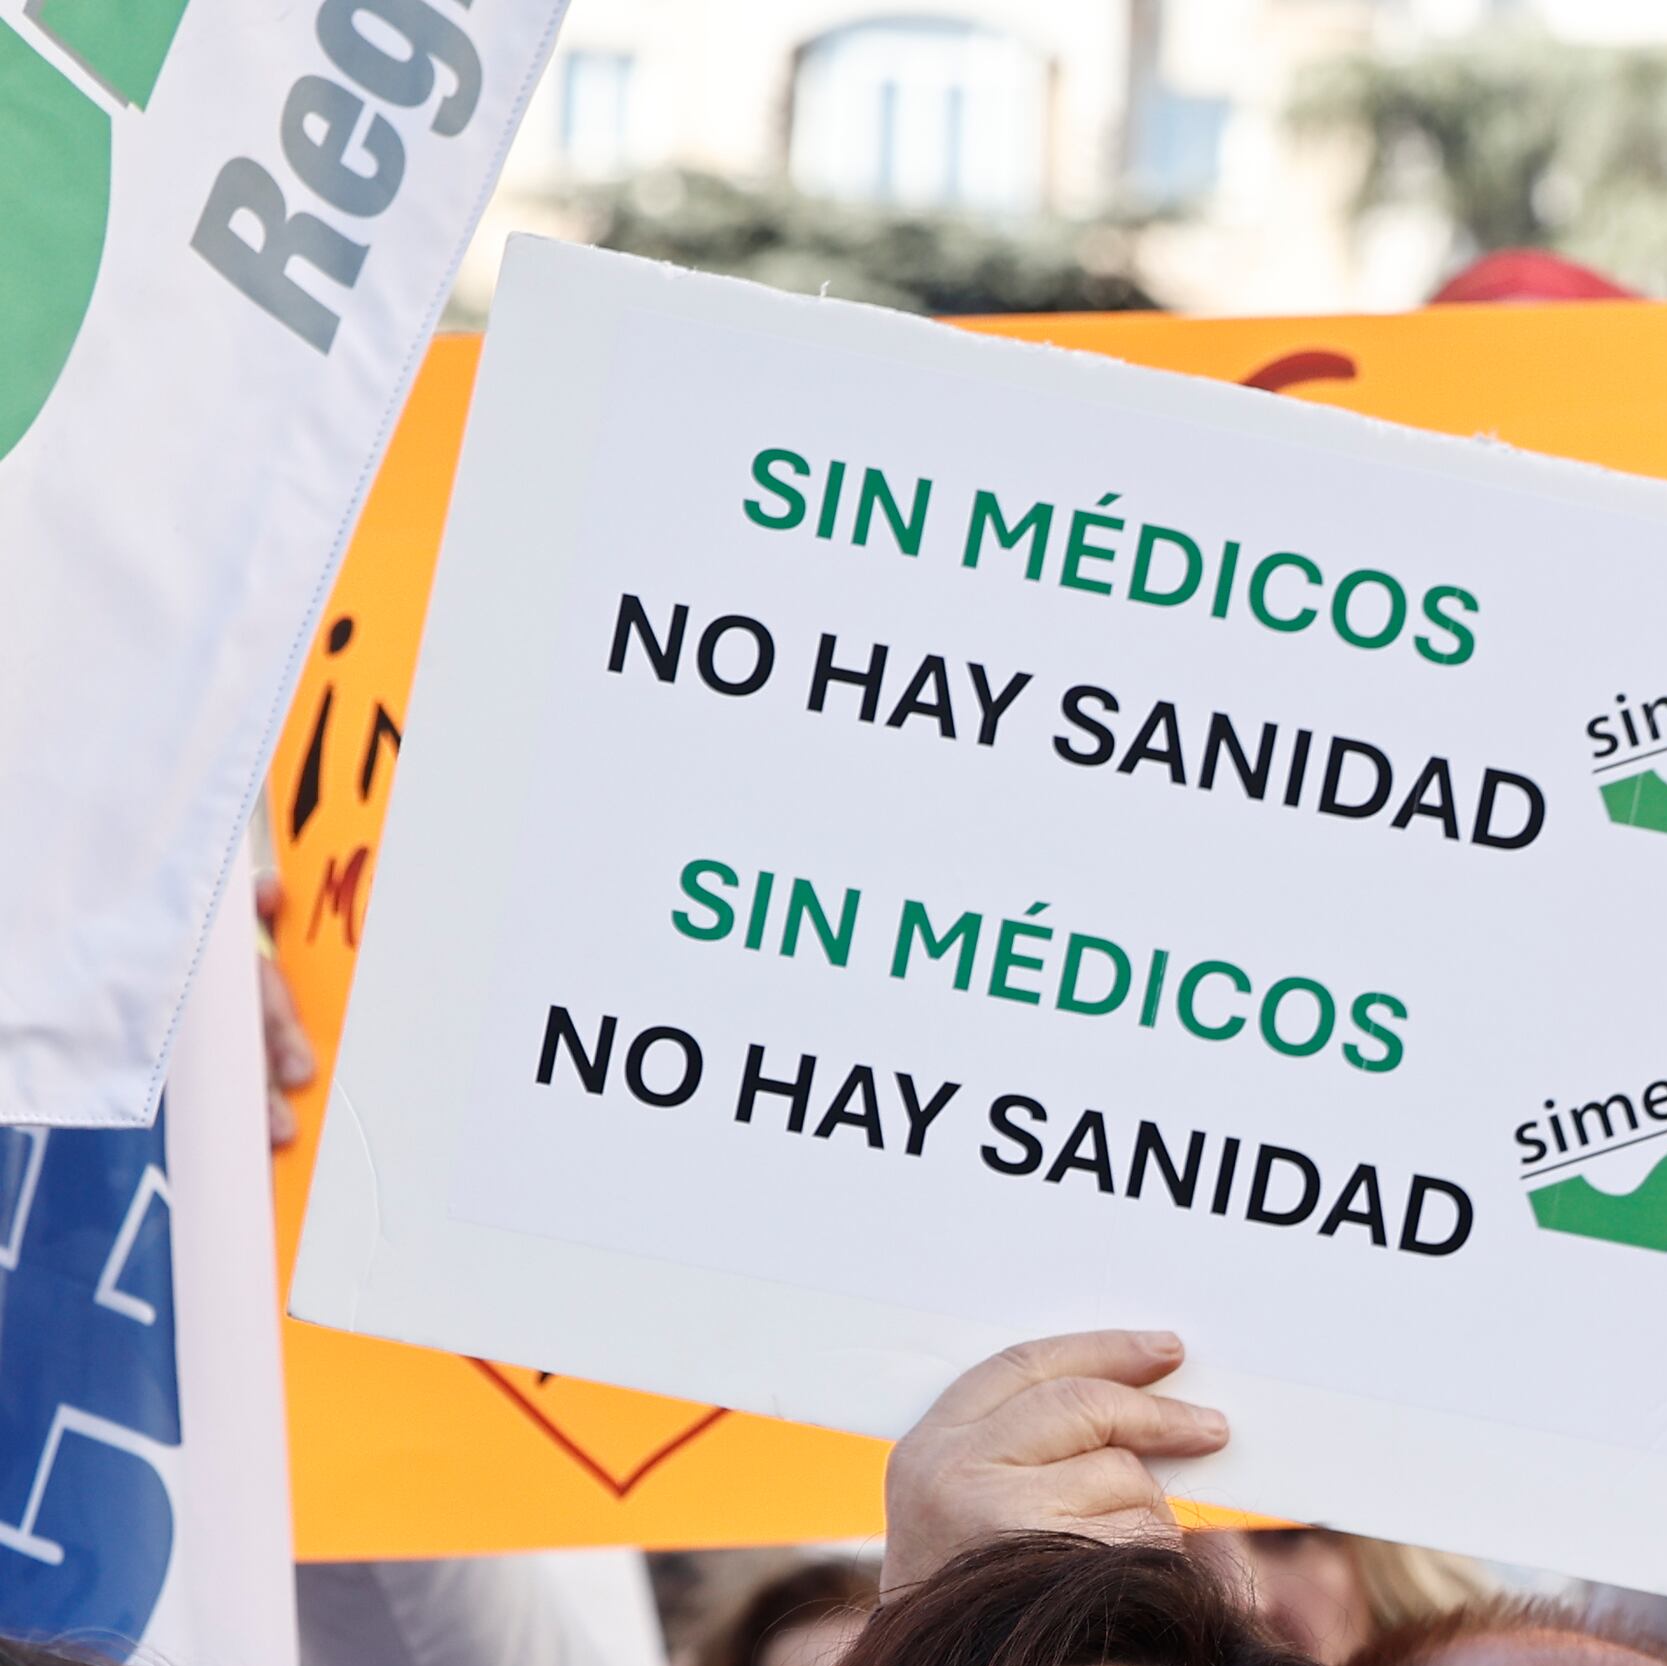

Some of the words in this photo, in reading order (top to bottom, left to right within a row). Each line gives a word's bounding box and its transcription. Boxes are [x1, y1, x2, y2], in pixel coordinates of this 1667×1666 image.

[189, 0, 482, 356] Reg
[743, 448, 933, 557] SIN
[963, 489, 1481, 666] MÉDICOS
[608, 593, 775, 697] NO
[807, 633, 1033, 747] HAY
[1053, 685, 1545, 850] SANIDAD
[672, 858, 862, 968] SIN
[891, 899, 1409, 1073] MÉDICOS
[536, 1005, 703, 1108] NO
[735, 1043, 961, 1157] HAY
[981, 1094, 1474, 1256] SANIDAD
